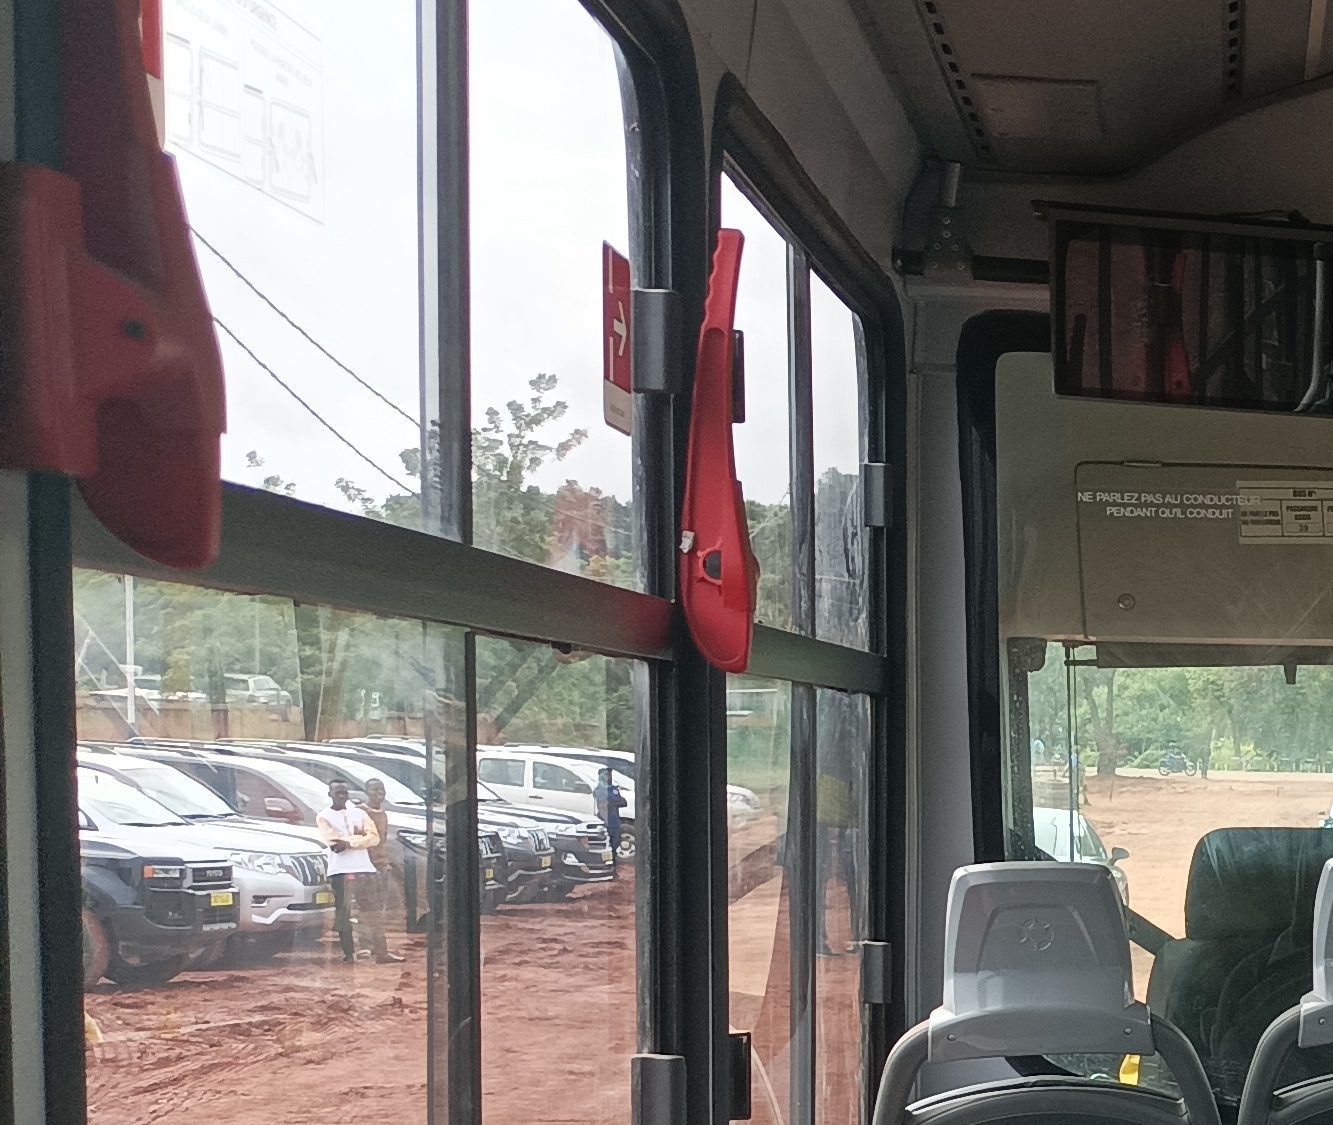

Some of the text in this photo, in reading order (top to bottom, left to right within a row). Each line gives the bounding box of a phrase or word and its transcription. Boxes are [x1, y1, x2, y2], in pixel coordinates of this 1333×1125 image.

[1077, 492, 1261, 505] NE PARLEZ PAS AU CONDUCTEUR
[1107, 506, 1156, 517] PENDANT
[1159, 507, 1185, 518] QU'IL
[1186, 508, 1234, 518] CONDUIT
